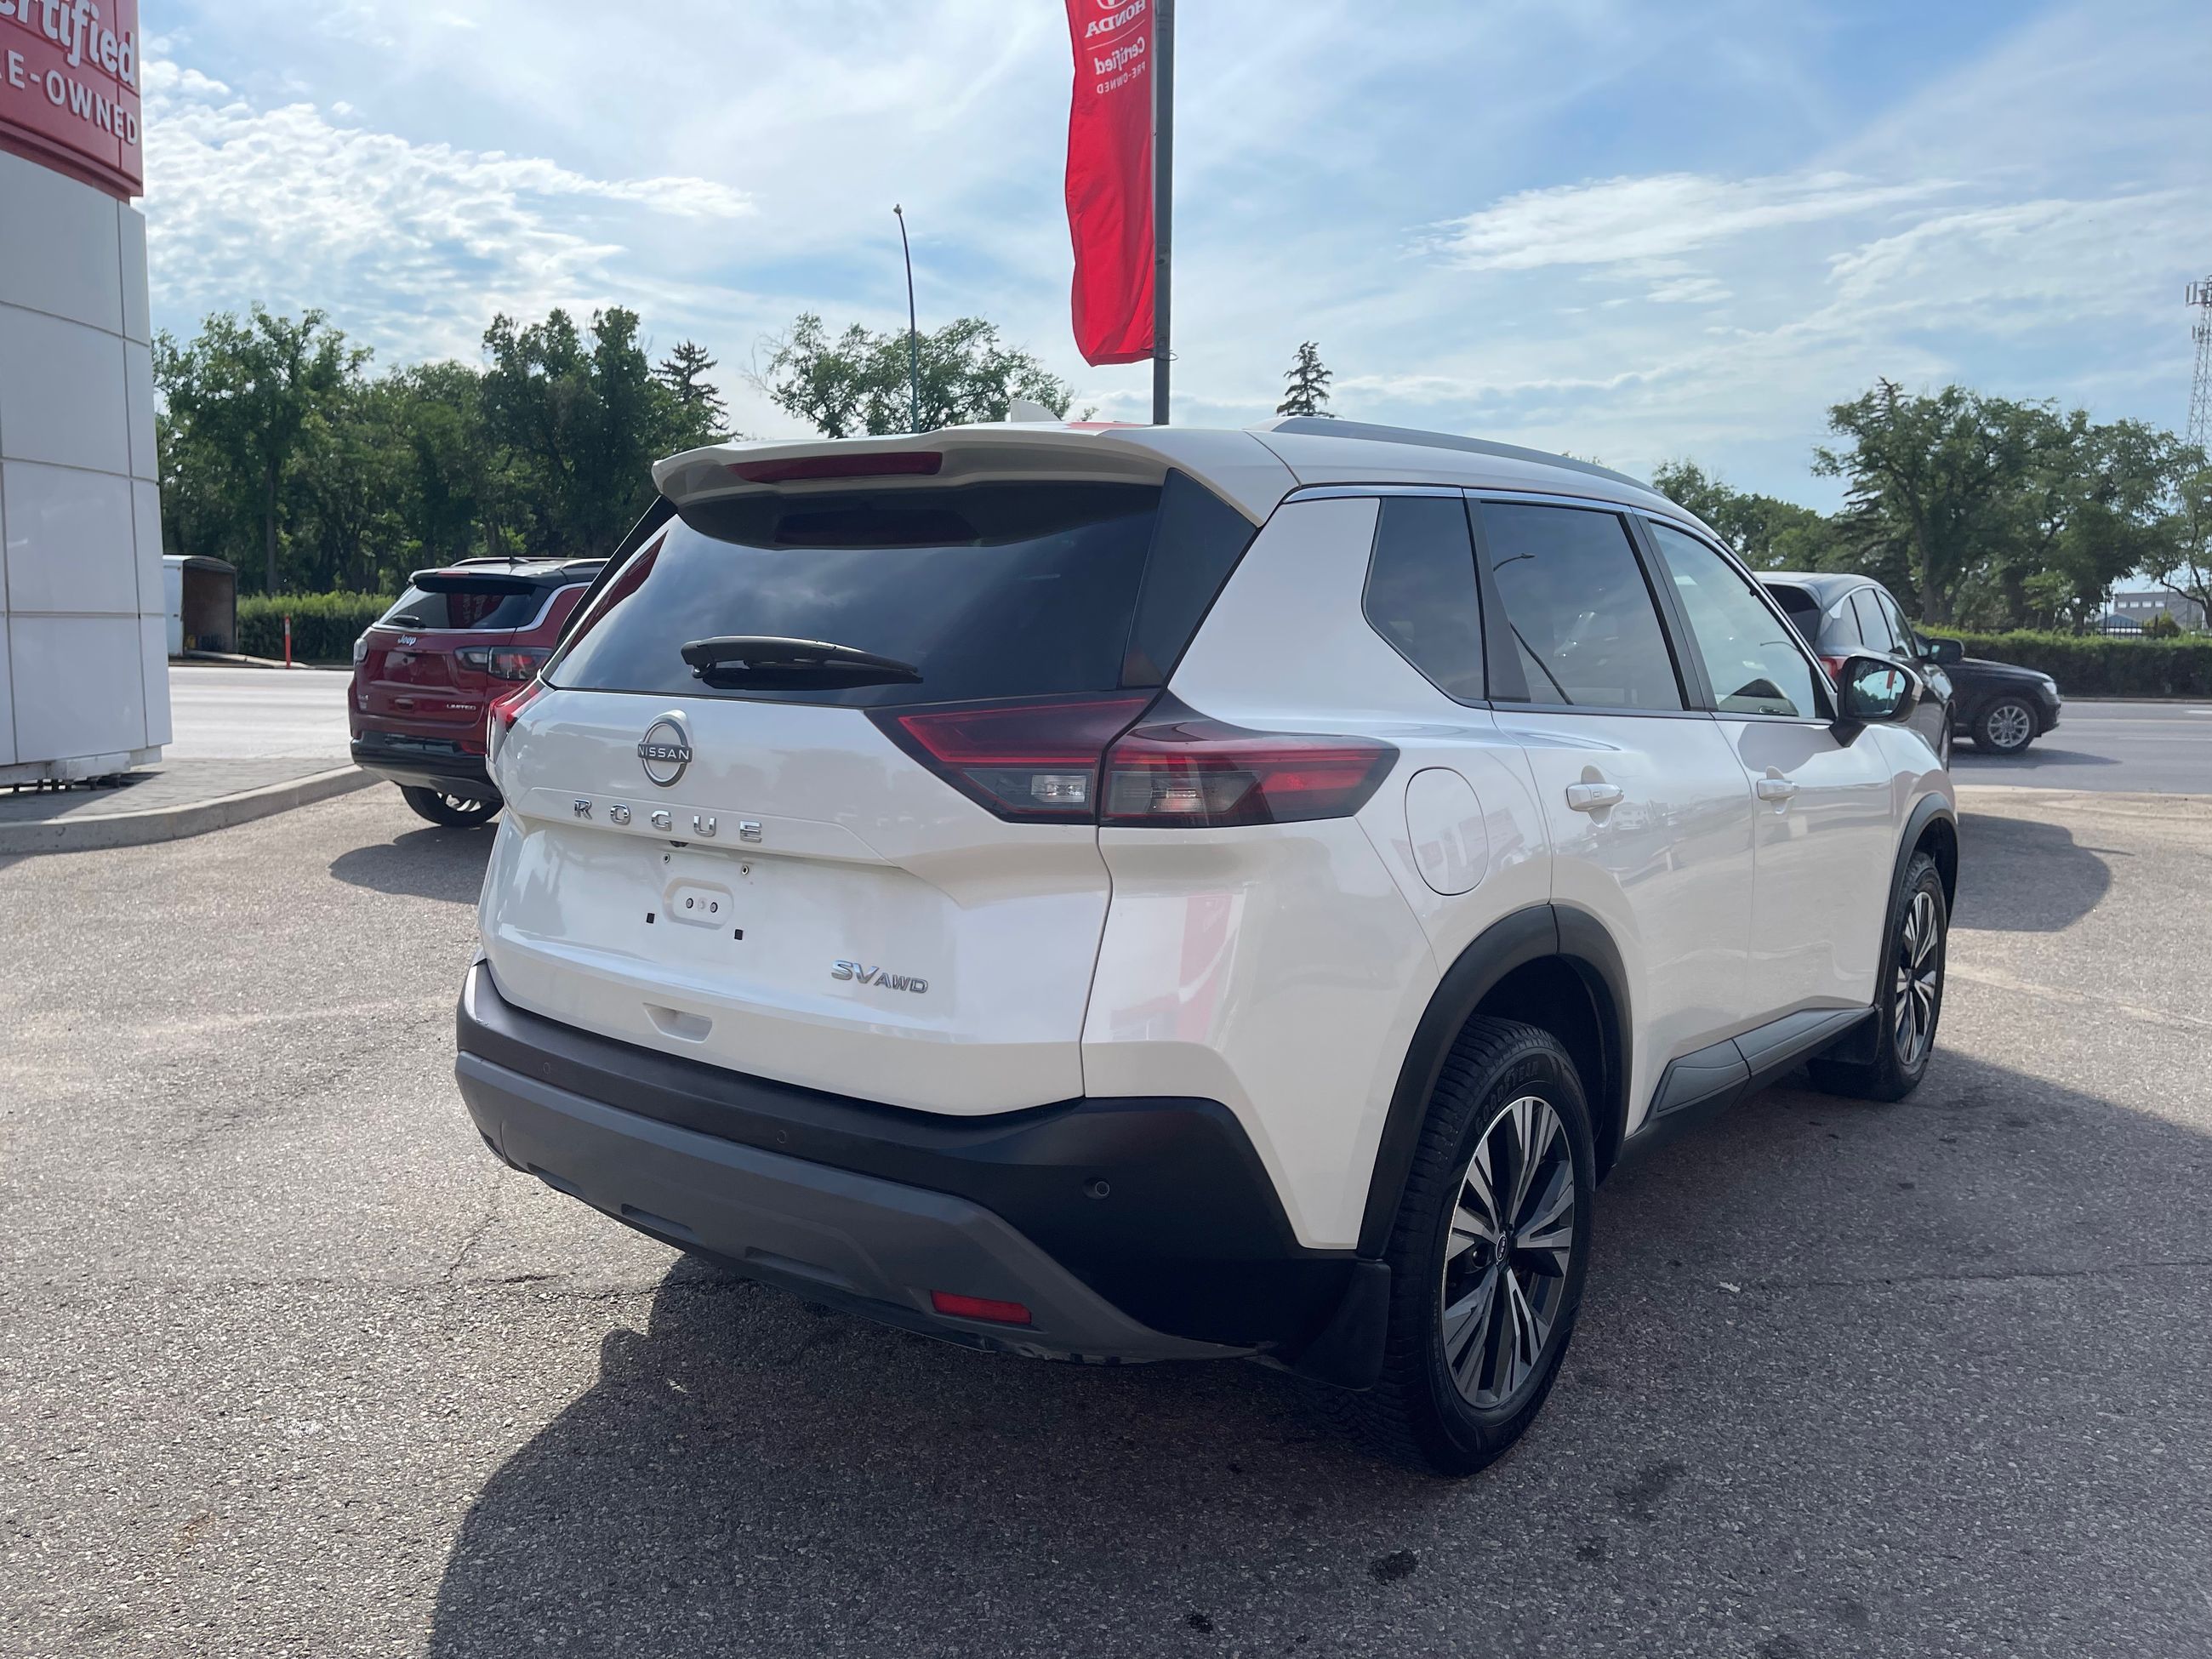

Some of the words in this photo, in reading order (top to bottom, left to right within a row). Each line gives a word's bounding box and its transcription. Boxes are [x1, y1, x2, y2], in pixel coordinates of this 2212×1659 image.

[0, 49, 138, 145] E-OWNED
[397, 634, 417, 647] Jeep
[638, 745, 690, 761] NISSAN
[573, 798, 762, 843] ROGUE
[830, 960, 880, 985] SV
[873, 972, 929, 994] AWD
